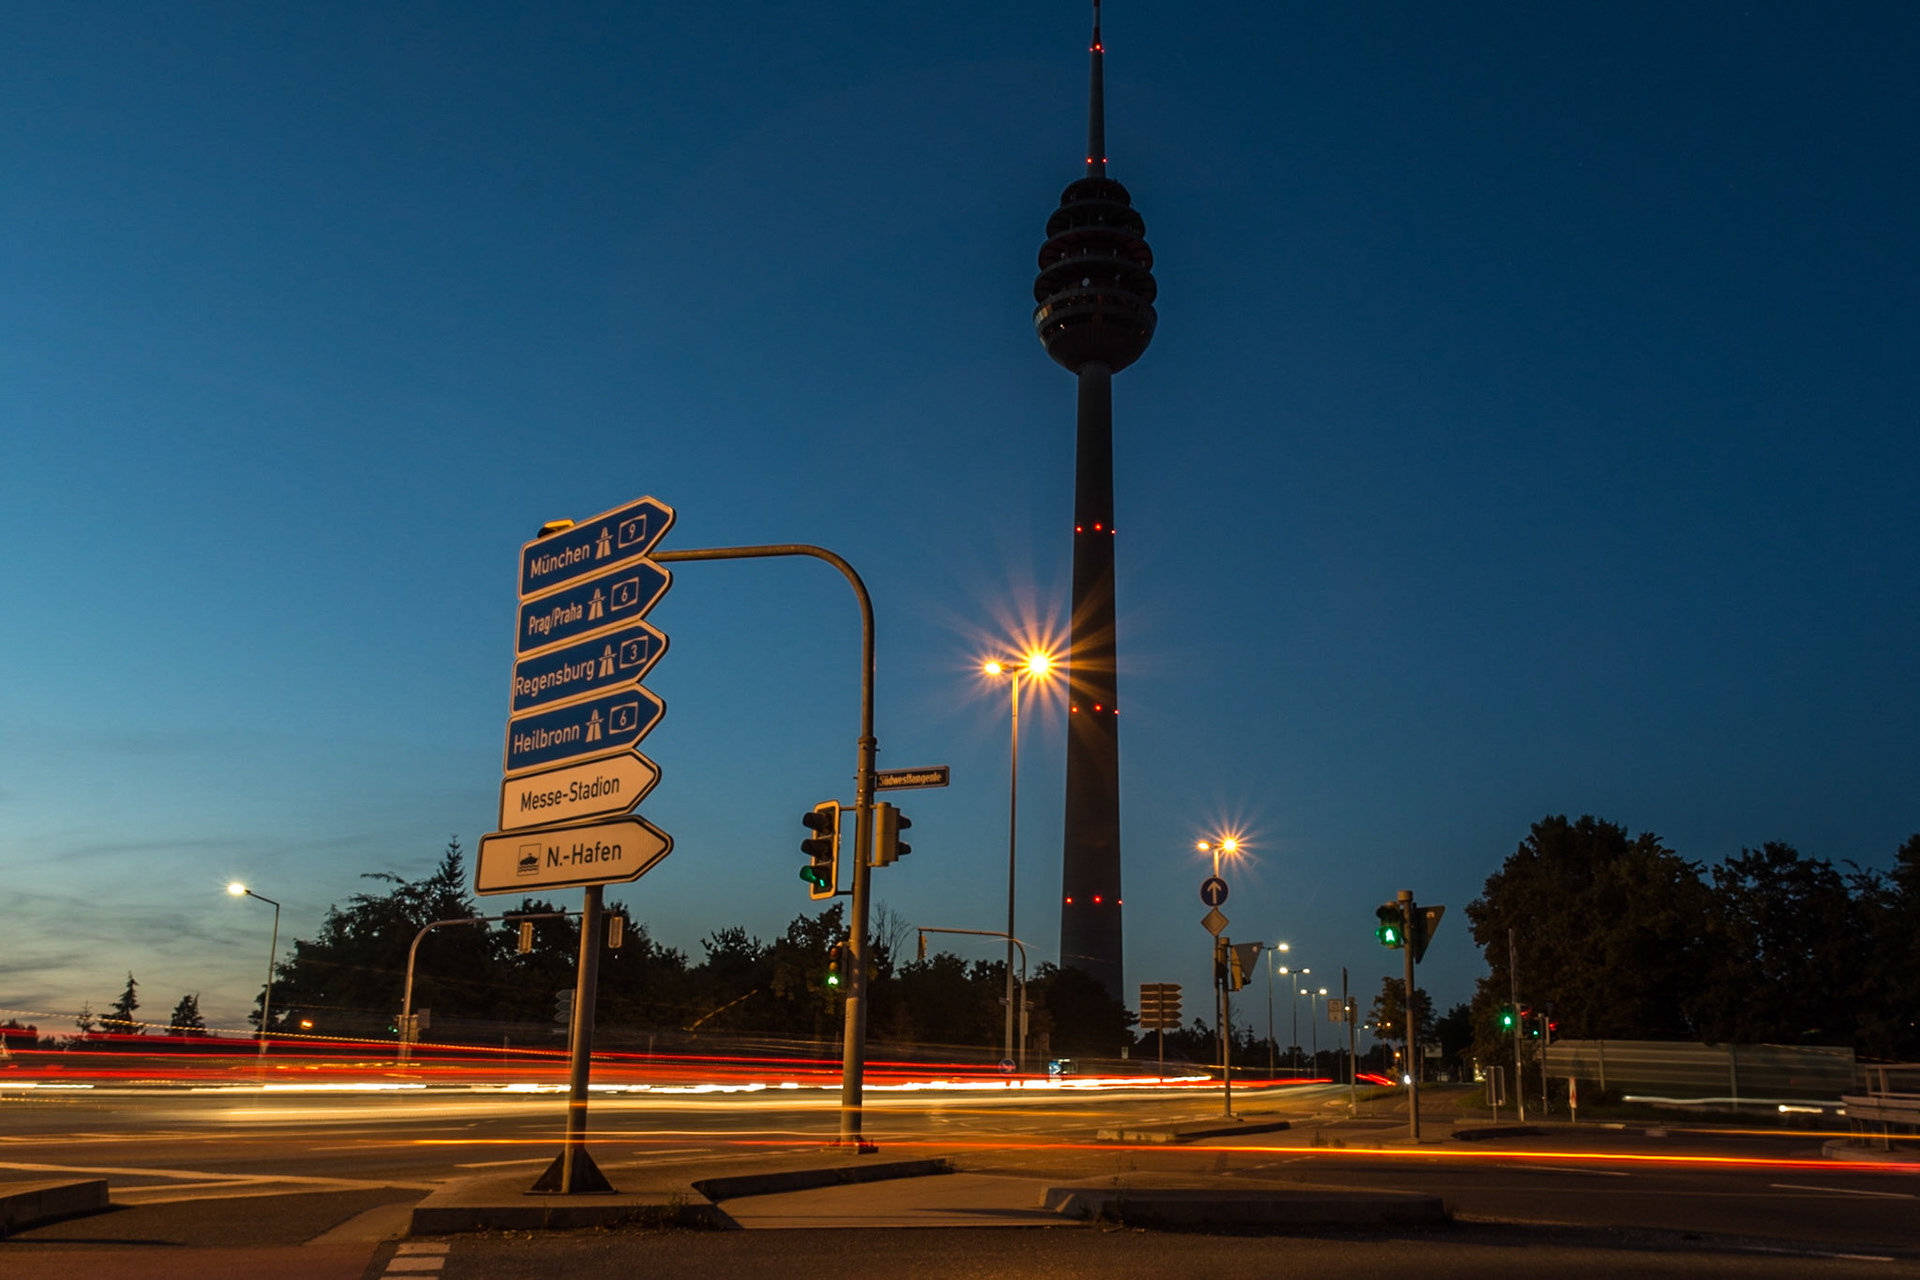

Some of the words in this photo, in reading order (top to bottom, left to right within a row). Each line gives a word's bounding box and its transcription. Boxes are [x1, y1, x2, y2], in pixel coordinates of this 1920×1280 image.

[530, 544, 590, 579] München
[629, 523, 636, 540] 9
[528, 602, 583, 636] Prag/Praha
[621, 586, 628, 602] 6
[515, 659, 595, 698] Regensburg
[630, 644, 637, 660] 3
[513, 724, 580, 755] Heilbronn
[619, 710, 627, 726] 6
[520, 776, 620, 812] Messe-Stadion
[546, 841, 622, 868] N.-Hafen
